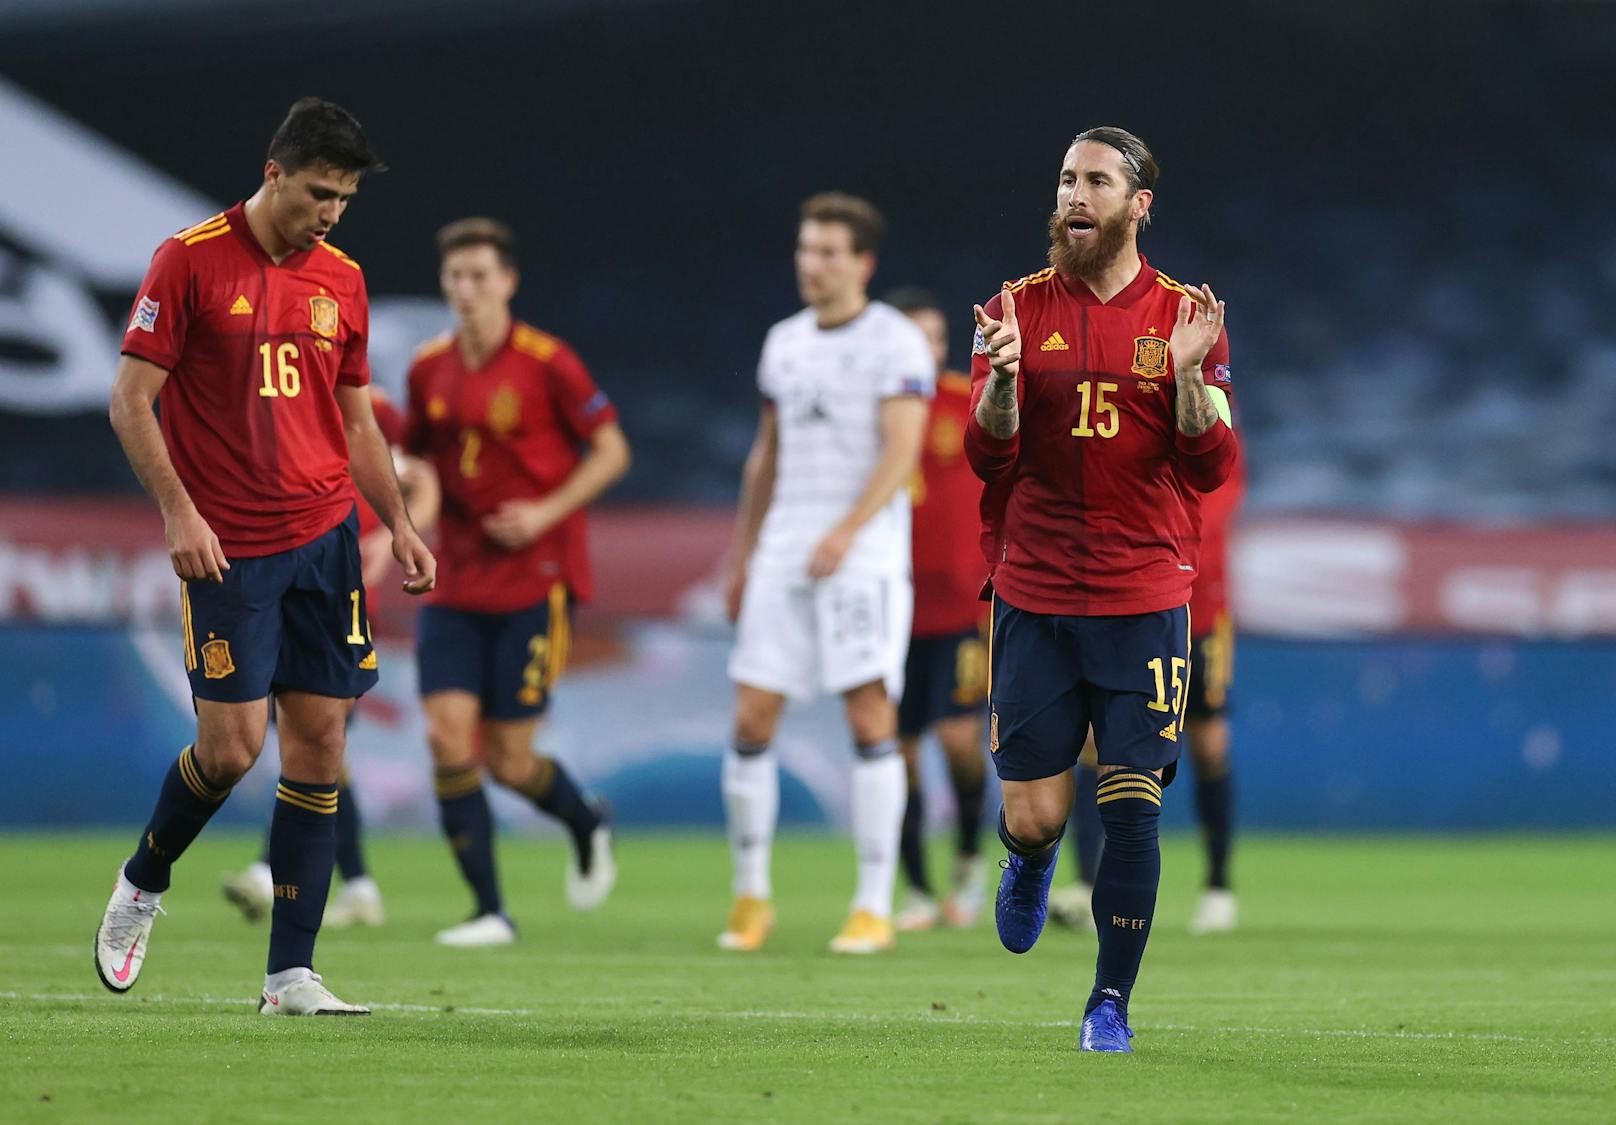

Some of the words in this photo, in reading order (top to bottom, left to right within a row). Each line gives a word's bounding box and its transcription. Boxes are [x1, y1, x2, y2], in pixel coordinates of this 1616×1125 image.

[259, 342, 300, 397] 16
[1040, 343, 1070, 351] adidas
[1071, 381, 1120, 438] 15
[346, 589, 372, 645] 1
[1147, 656, 1186, 715] 15
[1112, 915, 1146, 930] RFEF
